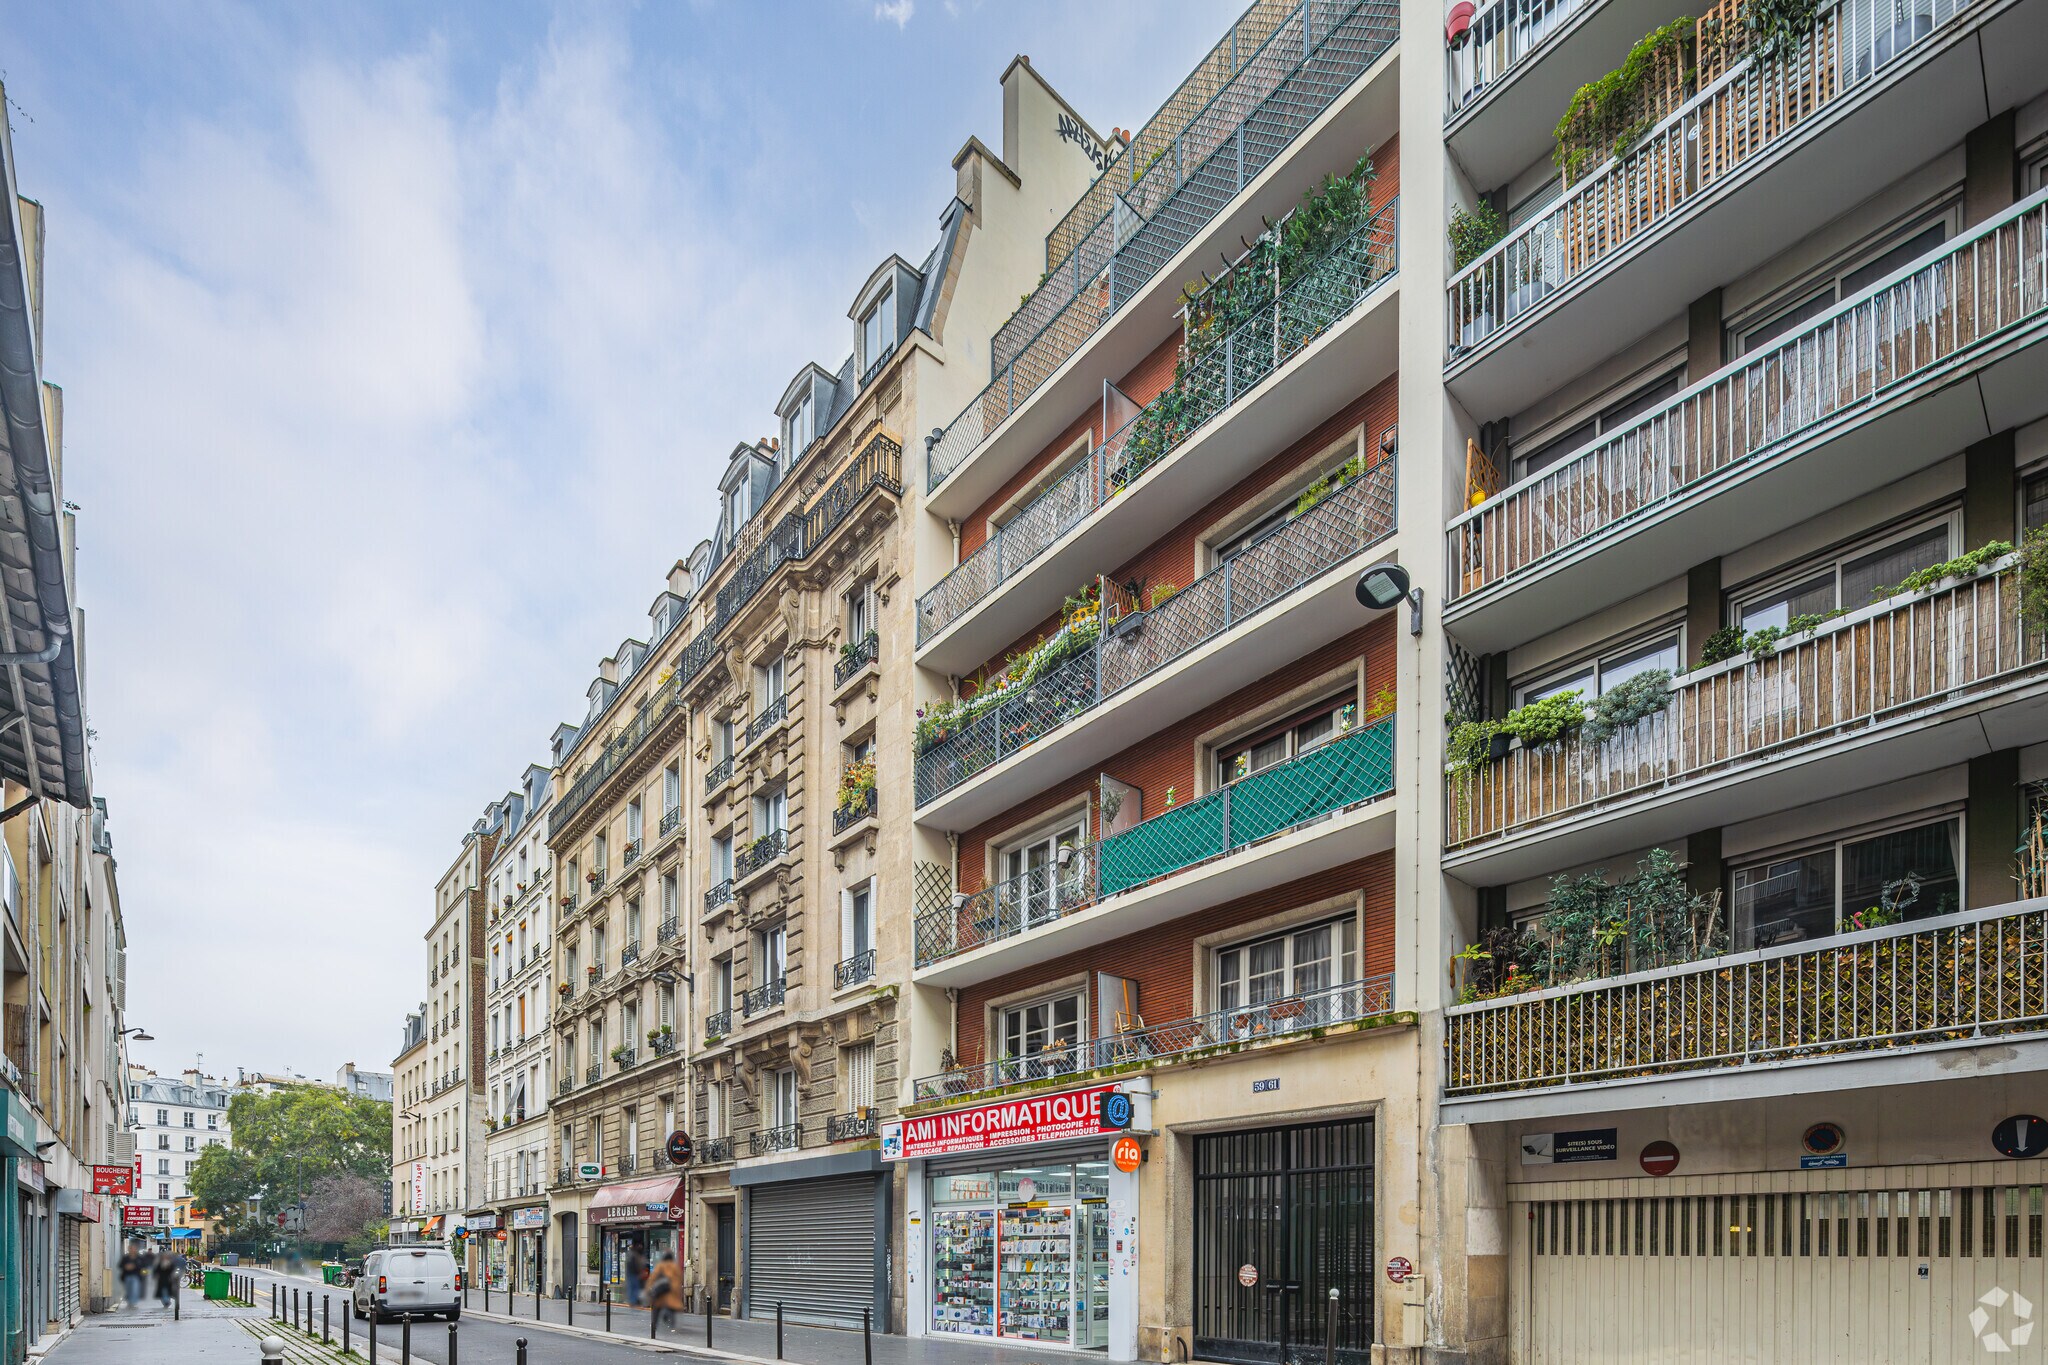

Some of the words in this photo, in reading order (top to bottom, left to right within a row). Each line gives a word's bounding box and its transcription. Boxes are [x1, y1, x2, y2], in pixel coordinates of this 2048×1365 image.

[1254, 1082, 1265, 1091] 59
[1268, 1080, 1278, 1089] 61
[906, 1119, 937, 1142] AMI
[941, 1092, 1101, 1137] INFORMATIQUE
[906, 1142, 936, 1150] MATERIELS
[937, 1135, 984, 1146] INFORMATIQUES
[990, 1127, 1031, 1139] IMPRESSION
[1036, 1121, 1084, 1133] PHOTOCOPIE
[910, 1148, 942, 1156] DEBLOCAGE
[947, 1142, 984, 1152] REPARATION
[990, 1134, 1036, 1146] ACCESSOIRES
[1037, 1126, 1099, 1140] TELEPHONIQUES
[1117, 1141, 1138, 1160] ria
[1555, 1145, 1596, 1153] SURVEILLANCE
